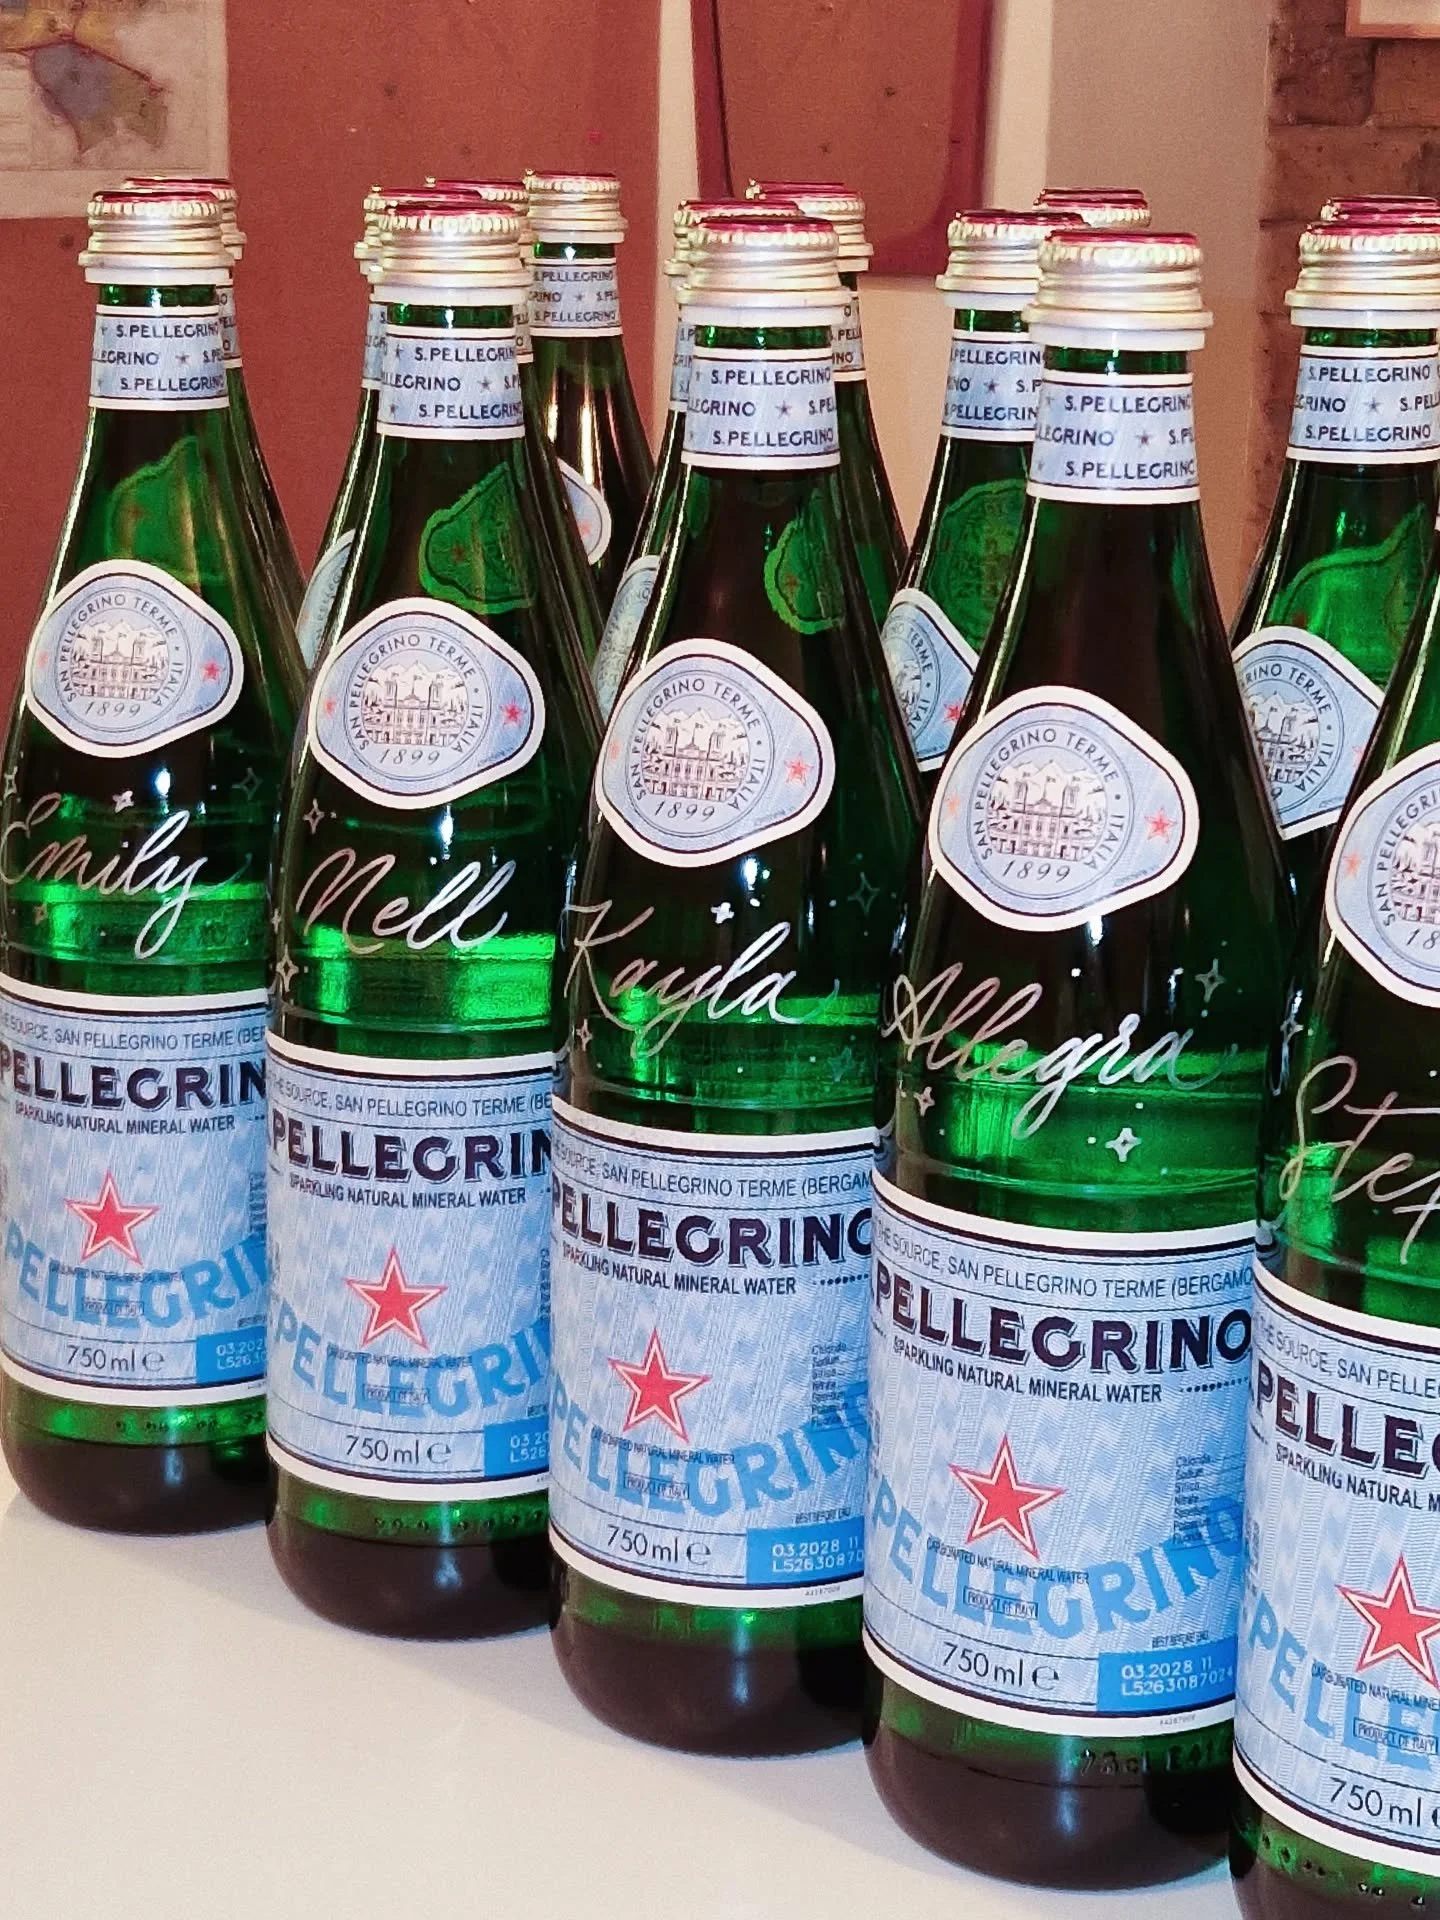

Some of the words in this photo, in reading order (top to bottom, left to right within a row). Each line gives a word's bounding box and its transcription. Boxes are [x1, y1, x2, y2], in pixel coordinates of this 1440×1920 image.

[1306, 424, 1431, 442] S.PELLEGRINO
[60, 594, 125, 663] PELLEGRINO
[133, 596, 178, 637] TERME
[350, 633, 421, 709] PELLEGRINO
[429, 636, 477, 680] TERME
[59, 671, 79, 703] SAN
[151, 661, 184, 707] ITALIA
[1288, 668, 1333, 715] TERME
[84, 701, 141, 717] 1899
[631, 678, 705, 755] PELLEGRINO
[713, 681, 761, 731] TERME
[350, 718, 371, 751] SAN
[451, 703, 485, 754] ITALIA
[379, 748, 441, 765] 1899
[975, 728, 1057, 811] PELLEGRINO
[1066, 731, 1120, 782] TERME
[1294, 742, 1334, 793] ITALIA
[631, 763, 648, 801] SAN
[727, 757, 766, 811] ITALIA
[654, 800, 716, 823] 1899
[975, 821, 994, 862] SAN
[1082, 813, 1126, 871] ITALIA
[0, 791, 252, 960] Emily
[1002, 860, 1072, 883] 1899
[296, 848, 517, 955] Nell
[1375, 883, 1397, 927] SAN
[561, 899, 840, 1061] Kayla
[55, 1028, 80, 1046] SAN
[84, 1031, 178, 1050] PELLEGRINO
[183, 1031, 233, 1047] TERME
[881, 961, 1238, 1142] Allegra
[67, 1113, 122, 1134] NATURAL
[127, 1117, 185, 1135] MINERAL
[189, 1114, 235, 1134] WATER
[336, 1094, 362, 1113] SAN
[367, 1098, 467, 1118] PELLEGRINO
[472, 1096, 525, 1115] TERME
[348, 1187, 408, 1208] NATURAL
[412, 1190, 475, 1209] MINERAL
[478, 1187, 526, 1207] WATER
[602, 1161, 628, 1185] SAN
[631, 1169, 732, 1197] PELLEGRINO
[738, 1179, 796, 1198] TERME
[612, 1262, 669, 1289] NATURAL
[674, 1270, 740, 1294] MINERAL
[744, 1276, 796, 1295] WATER
[948, 1256, 979, 1281] SAN
[983, 1264, 1096, 1297] PELLEGRINO
[1104, 1271, 1165, 1298] TERME
[874, 1258, 1252, 1373] PELLEGRINO
[957, 1362, 1024, 1394] NATURAL
[1028, 1374, 1103, 1402] MINERAL
[1106, 1382, 1162, 1402] WATER
[1337, 1358, 1371, 1386] SAN
[1275, 1443, 1343, 1489] SPARKLING
[1346, 1473, 1423, 1510] NATURAL
[1121, 1660, 1193, 1679] 03.2028
